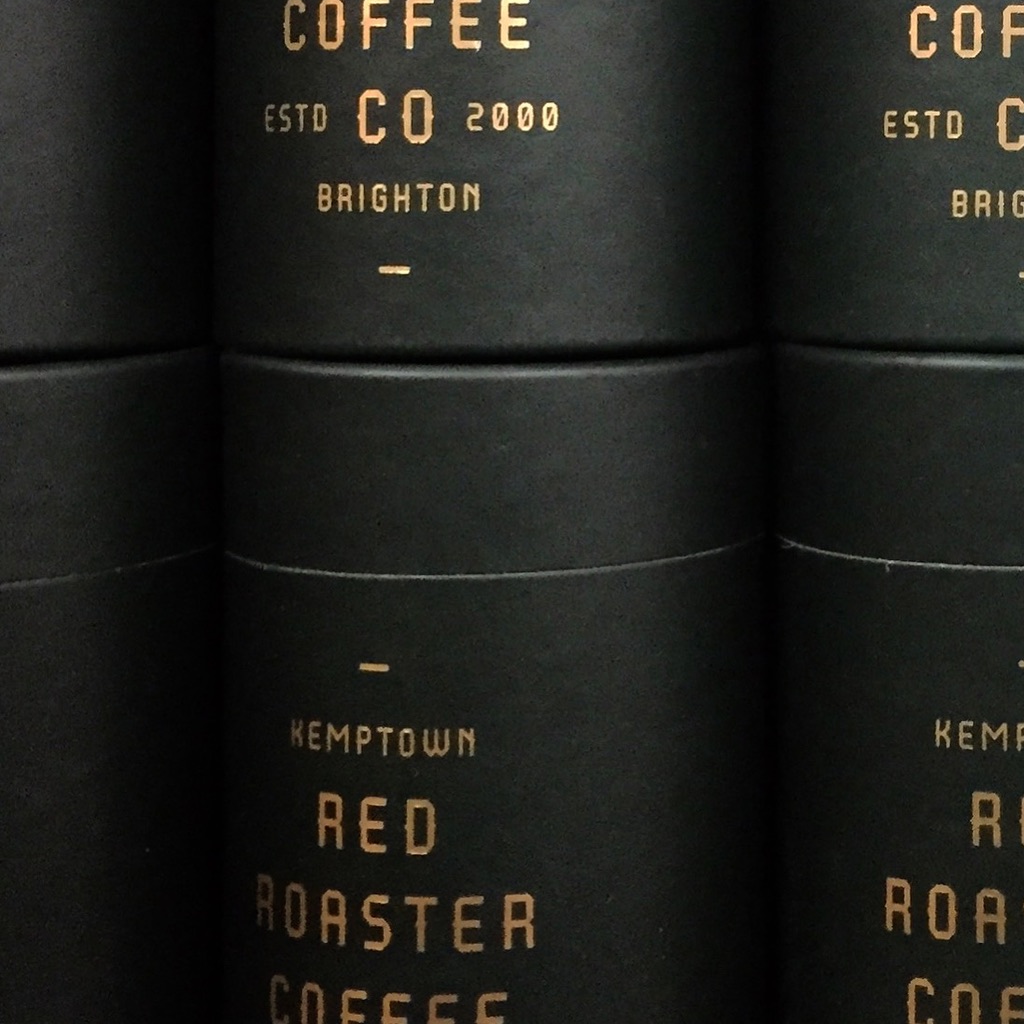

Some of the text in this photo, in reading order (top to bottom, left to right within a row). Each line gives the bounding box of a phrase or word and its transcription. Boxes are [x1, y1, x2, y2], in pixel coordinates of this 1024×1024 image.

[265, 89, 558, 144] ESTD CO 2000
[884, 110, 963, 139] ESTD
[318, 183, 480, 212] BRIGHTON
[291, 720, 476, 758] KEMPTOWN
[317, 791, 436, 855] RED
[257, 874, 535, 953] ROASTER
